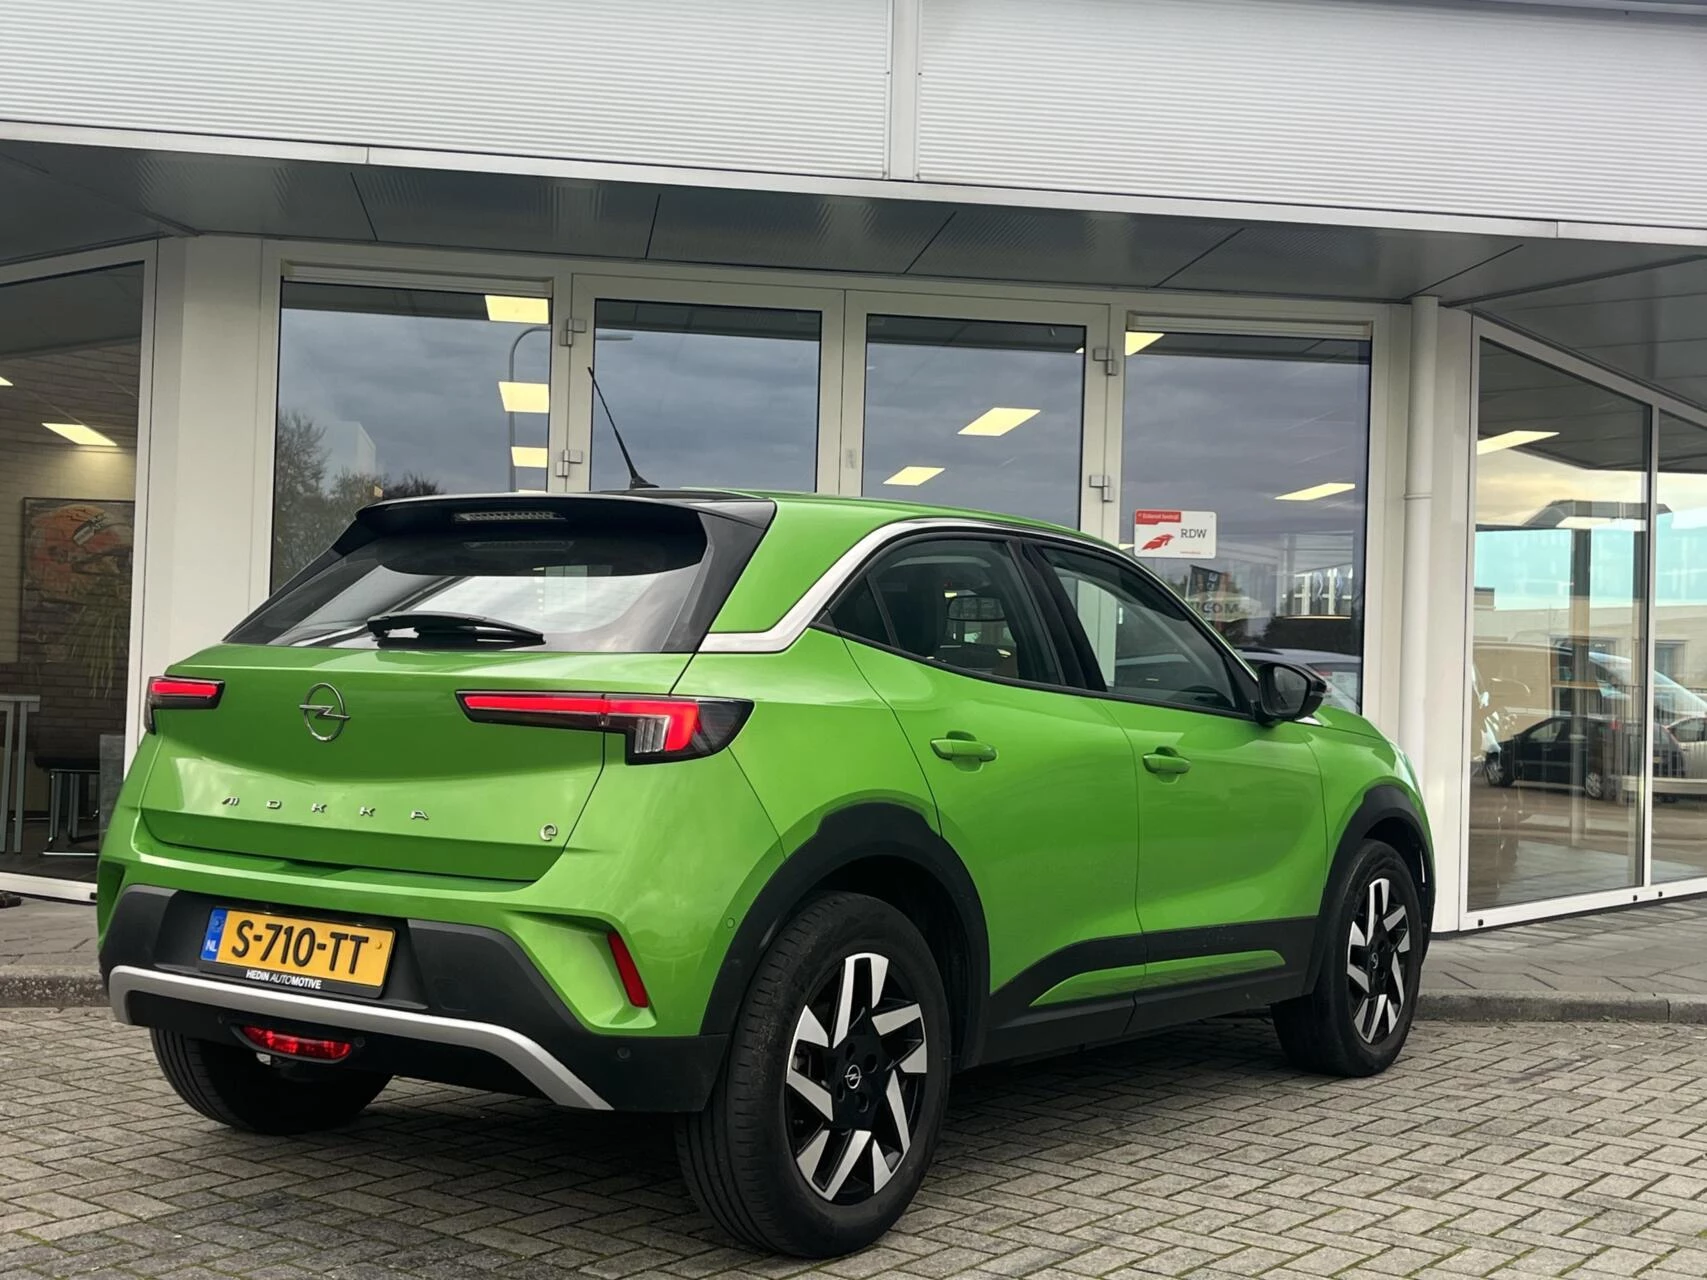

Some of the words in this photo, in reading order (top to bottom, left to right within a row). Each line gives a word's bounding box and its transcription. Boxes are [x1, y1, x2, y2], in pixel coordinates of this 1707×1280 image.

[1180, 528, 1207, 539] RDW
[222, 796, 429, 820] MOKKA
[205, 939, 217, 952] NL
[231, 919, 370, 975] S-710-TT
[245, 969, 270, 982] HEDIN
[269, 972, 322, 990] AUTOMOTIVE
